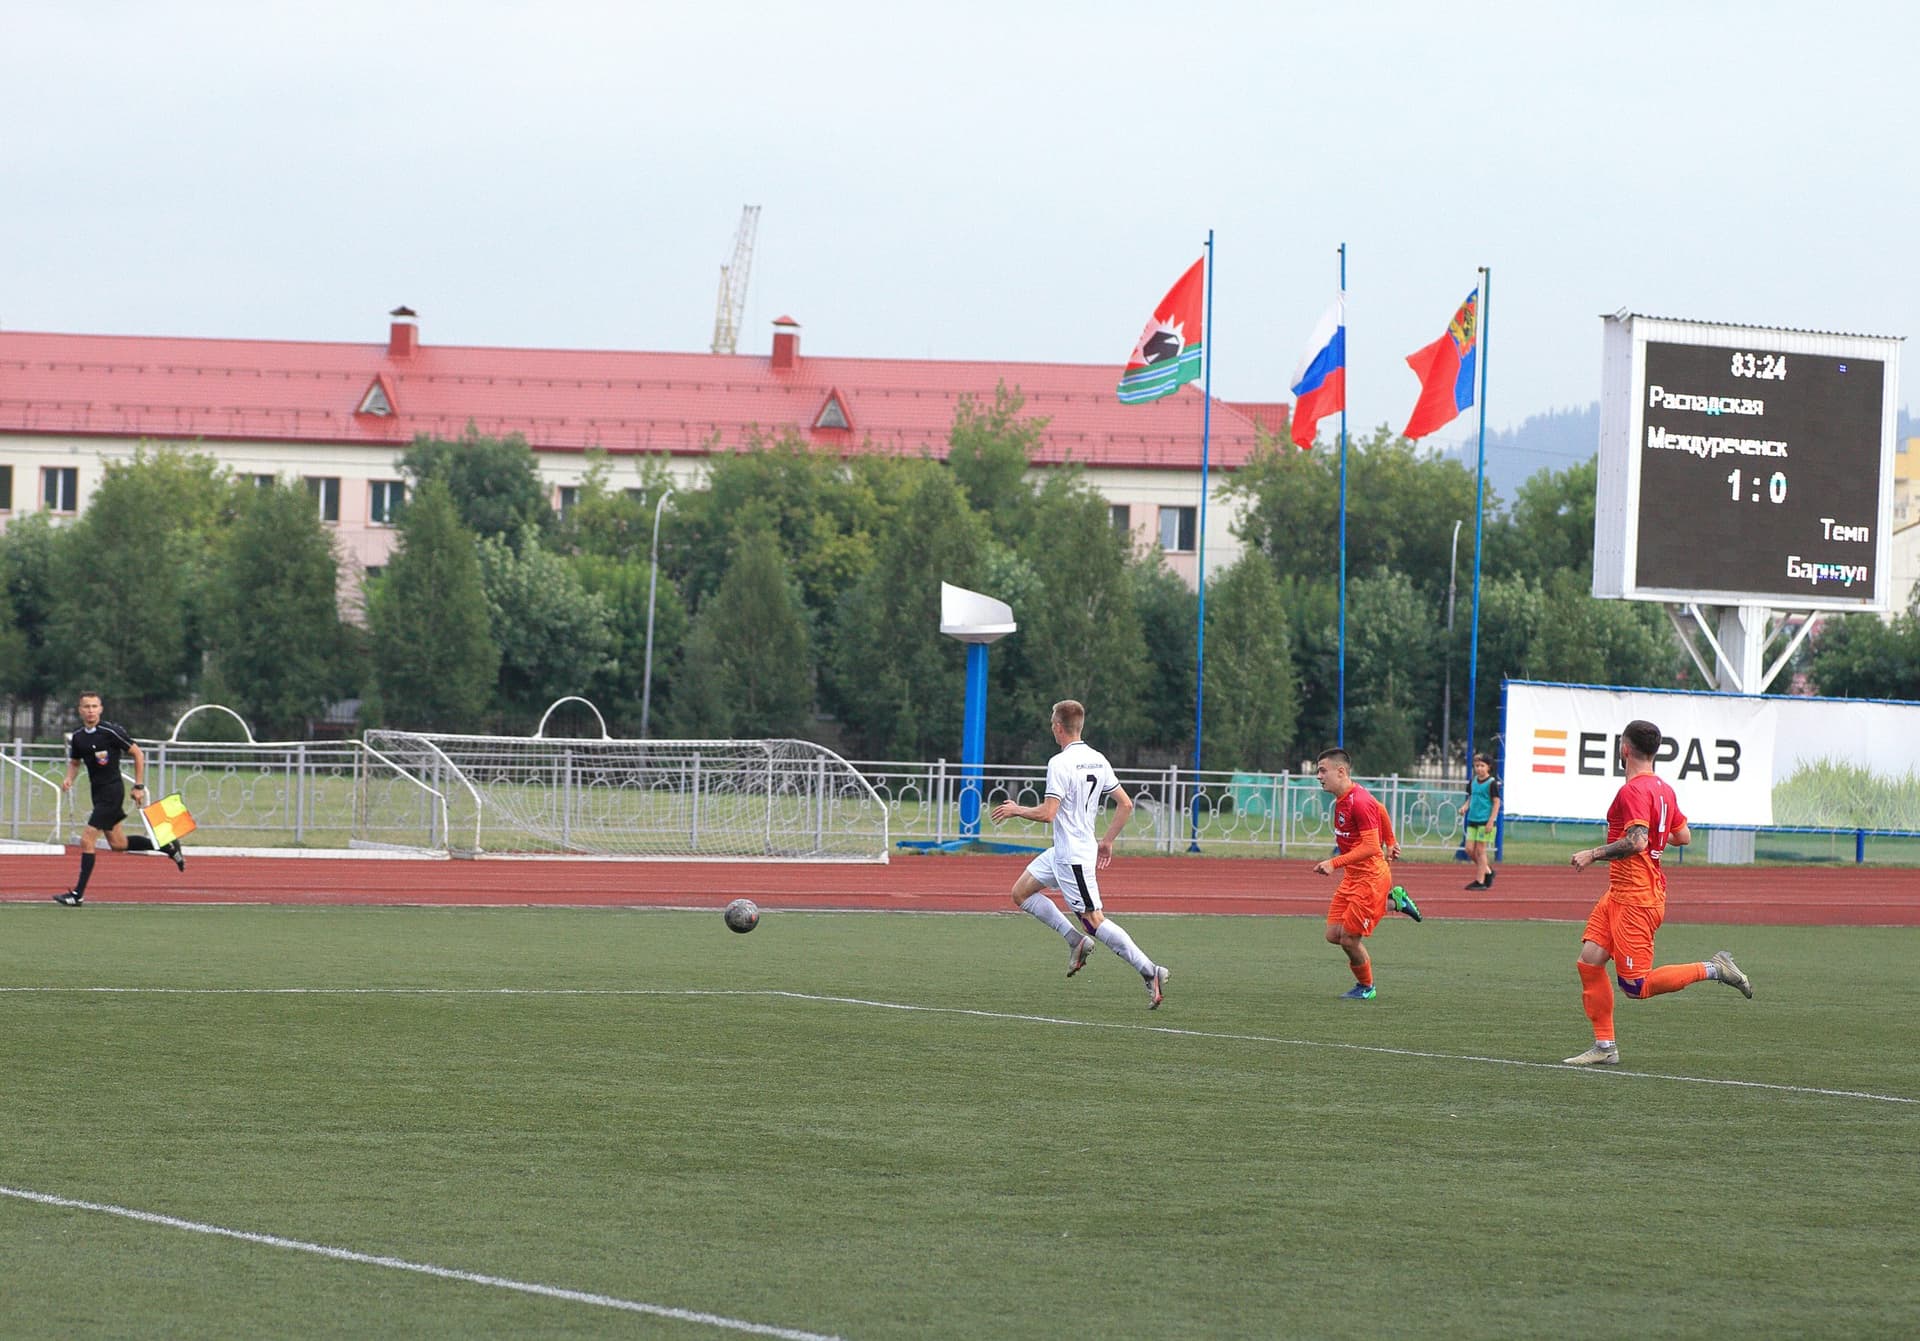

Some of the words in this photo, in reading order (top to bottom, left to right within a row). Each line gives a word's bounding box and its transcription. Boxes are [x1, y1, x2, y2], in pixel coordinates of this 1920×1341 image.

[1731, 352, 1787, 380] 83:24
[1649, 385, 1764, 415] Распадская
[1820, 518, 1869, 542] Темп
[1085, 774, 1098, 813] 7
